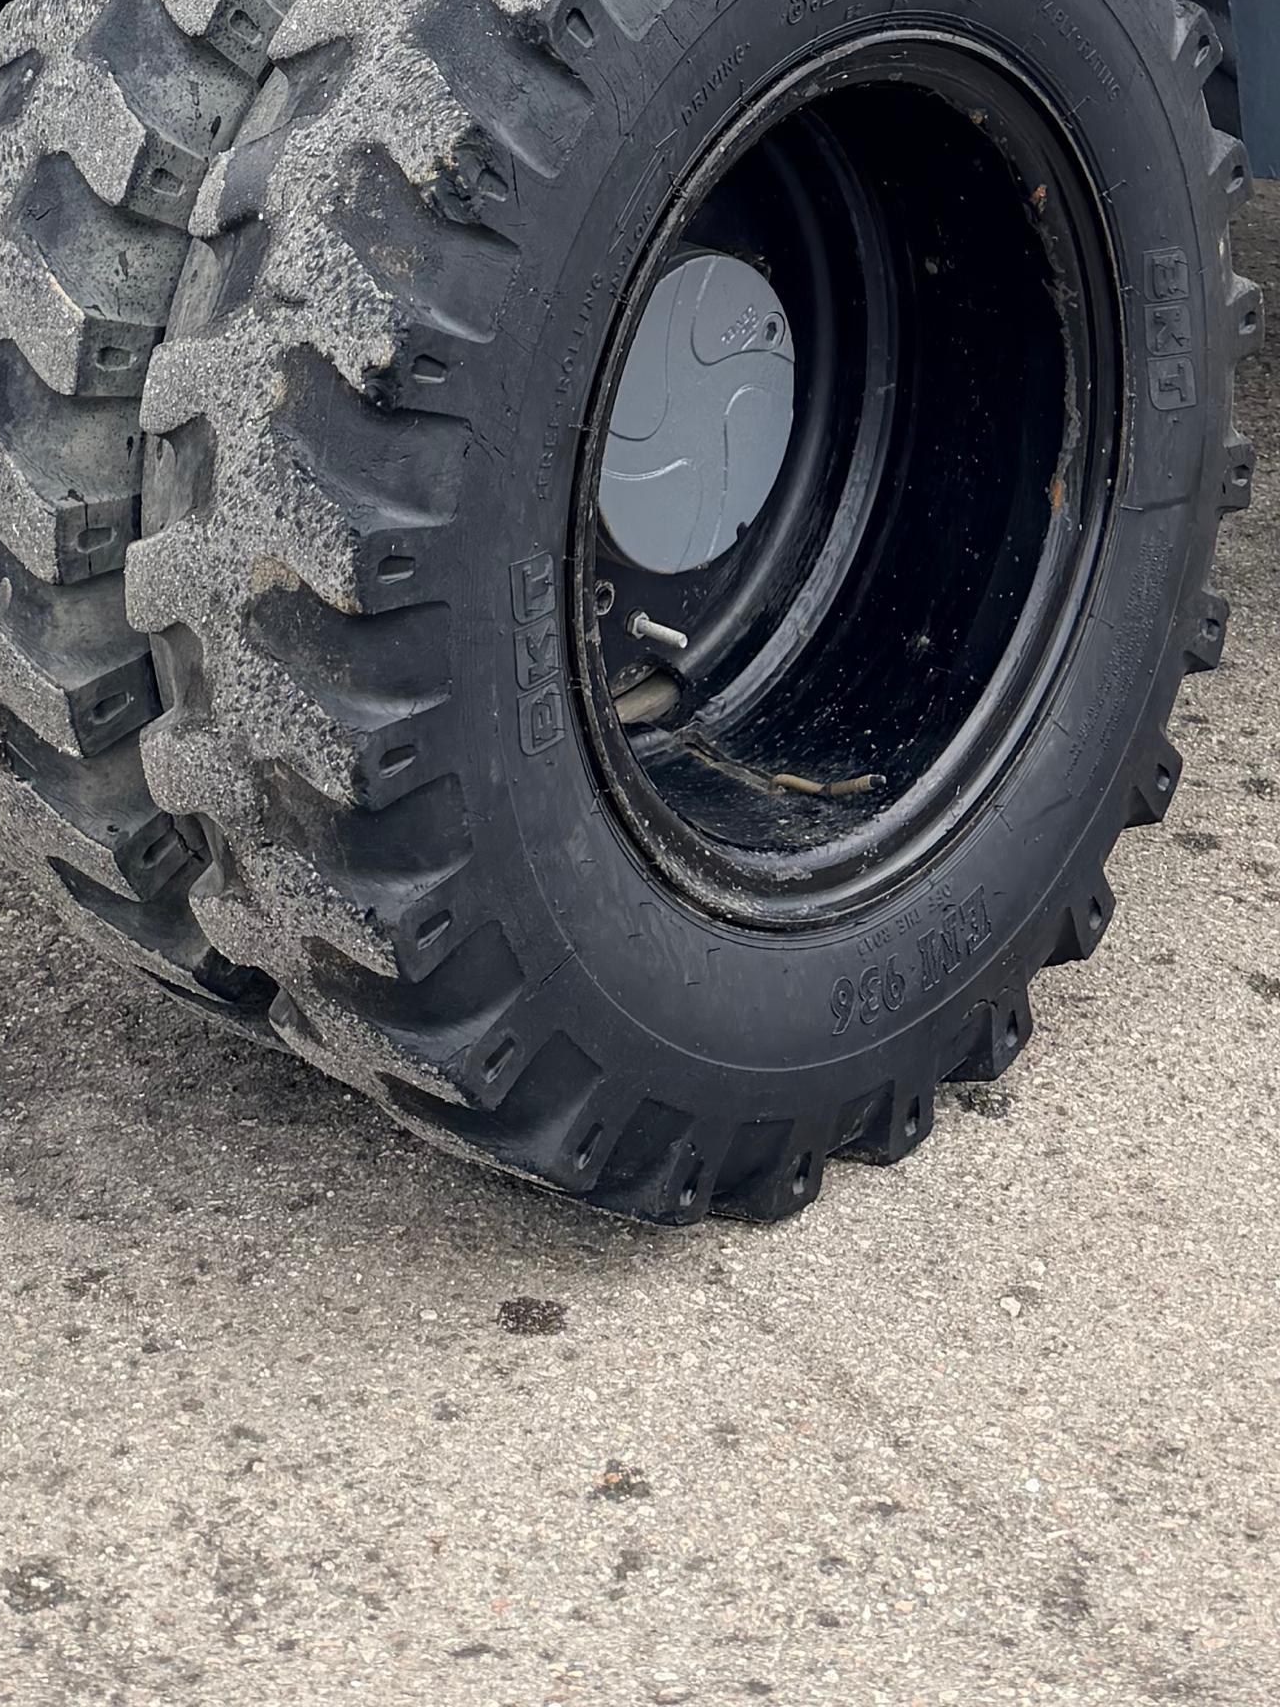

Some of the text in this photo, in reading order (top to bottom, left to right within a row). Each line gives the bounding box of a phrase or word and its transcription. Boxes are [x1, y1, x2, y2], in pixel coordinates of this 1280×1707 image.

[680, 42, 745, 127] DRIVING
[556, 272, 603, 393] ROLLING
[1147, 250, 1193, 405] BKT
[517, 557, 563, 752] BKT
[831, 953, 906, 1034] 936
